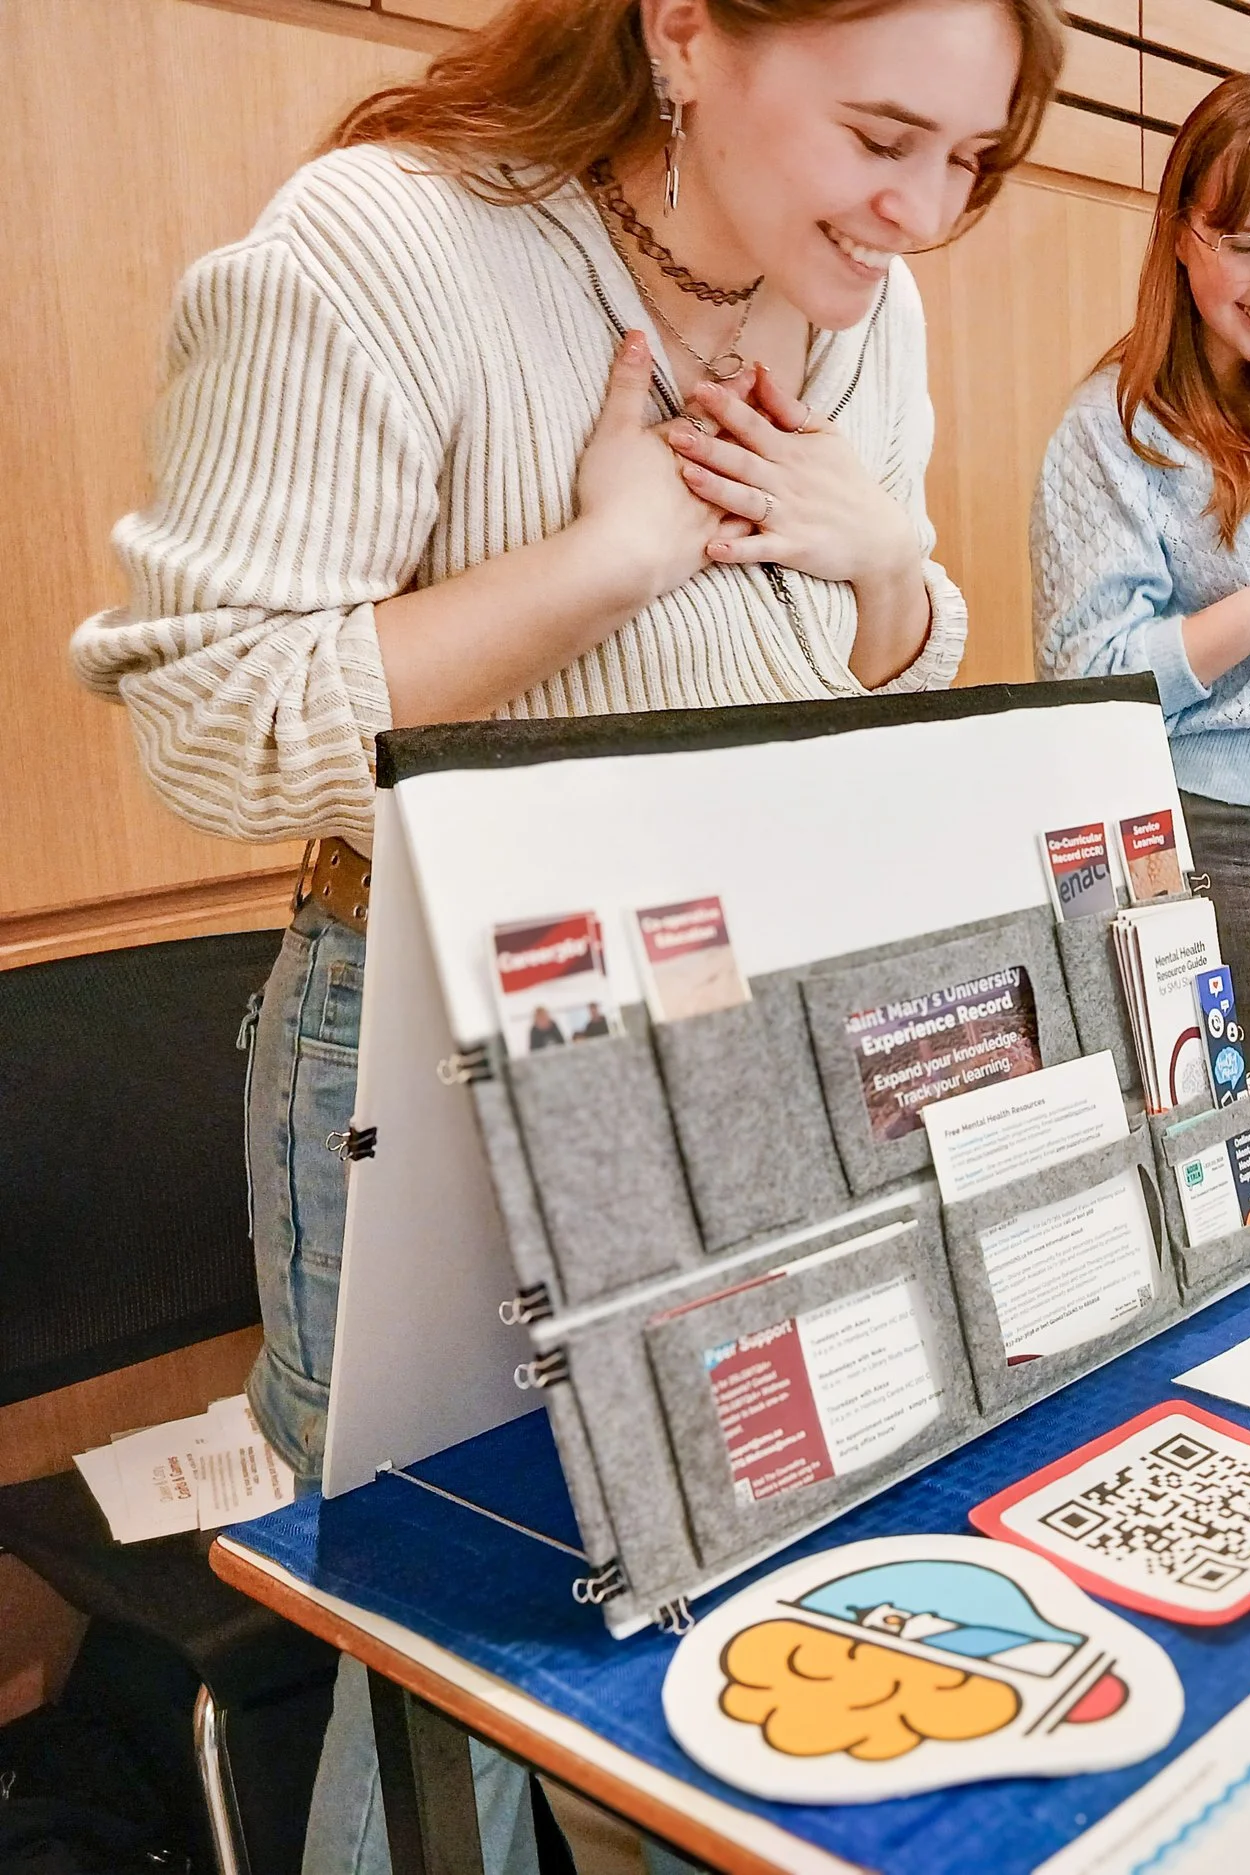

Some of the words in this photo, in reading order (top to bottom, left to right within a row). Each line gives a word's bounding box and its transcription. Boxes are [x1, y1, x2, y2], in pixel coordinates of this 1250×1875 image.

[1133, 821, 1160, 836] Service
[1133, 834, 1165, 850] Learning
[1060, 865, 1110, 904] enac
[1154, 950, 1179, 968] Mental
[1180, 941, 1206, 960] Health
[1156, 964, 1187, 983] Resource
[1187, 956, 1208, 972] Guide
[888, 992, 941, 1022] Mary's
[943, 968, 1022, 1003] University
[861, 1015, 956, 1056] Experience
[956, 991, 1014, 1024] Record
[873, 1061, 923, 1091] Expand
[924, 1052, 952, 1077] your
[953, 1031, 1021, 1063] knowledge.
[895, 1087, 932, 1108] Track
[933, 1075, 961, 1099] your
[962, 1055, 1013, 1083] learning.
[944, 1127, 960, 1139] Free
[961, 1116, 986, 1134] Mental
[986, 1108, 1010, 1125] Health
[1011, 1098, 1046, 1116] Resources
[738, 1320, 794, 1352] Support
